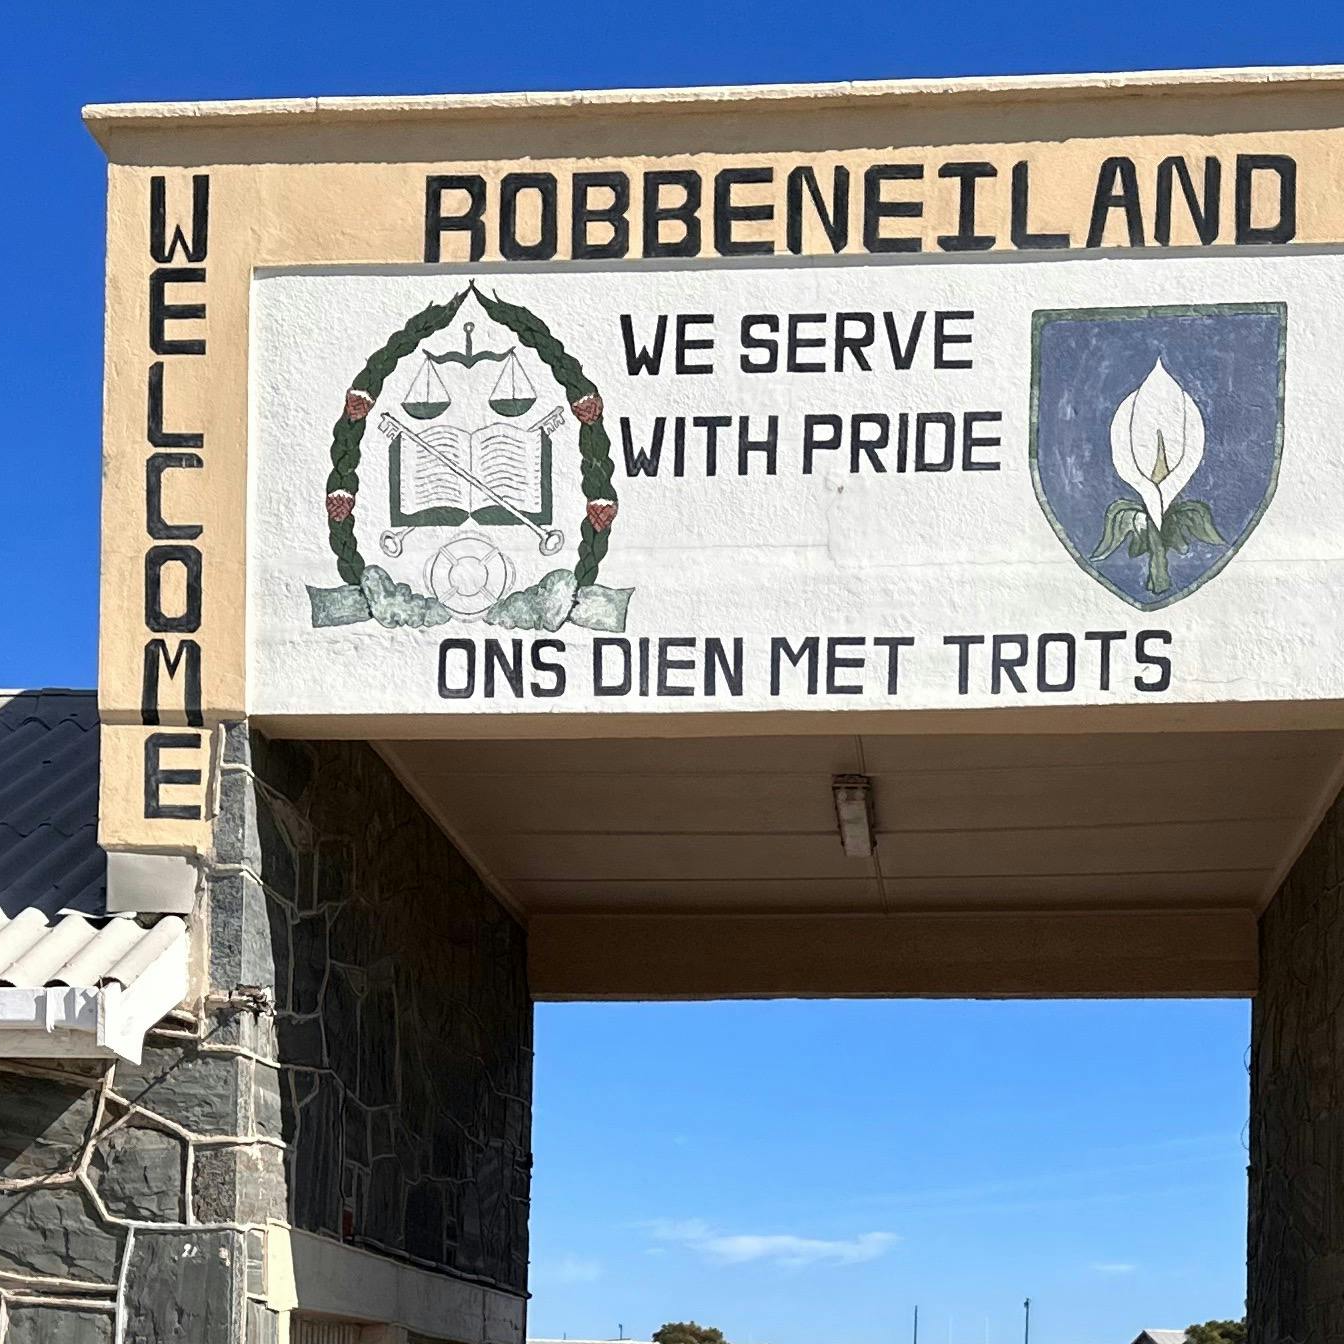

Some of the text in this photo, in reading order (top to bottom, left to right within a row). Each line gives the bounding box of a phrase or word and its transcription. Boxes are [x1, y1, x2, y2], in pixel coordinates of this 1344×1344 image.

[424, 153, 1297, 264] ROBBENEILAND
[620, 311, 975, 376] WE SERVE
[620, 411, 1002, 478] WITH PRIDE
[143, 174, 209, 821] WELCOME
[437, 629, 1172, 699] ONS DIEN MET TROTS
